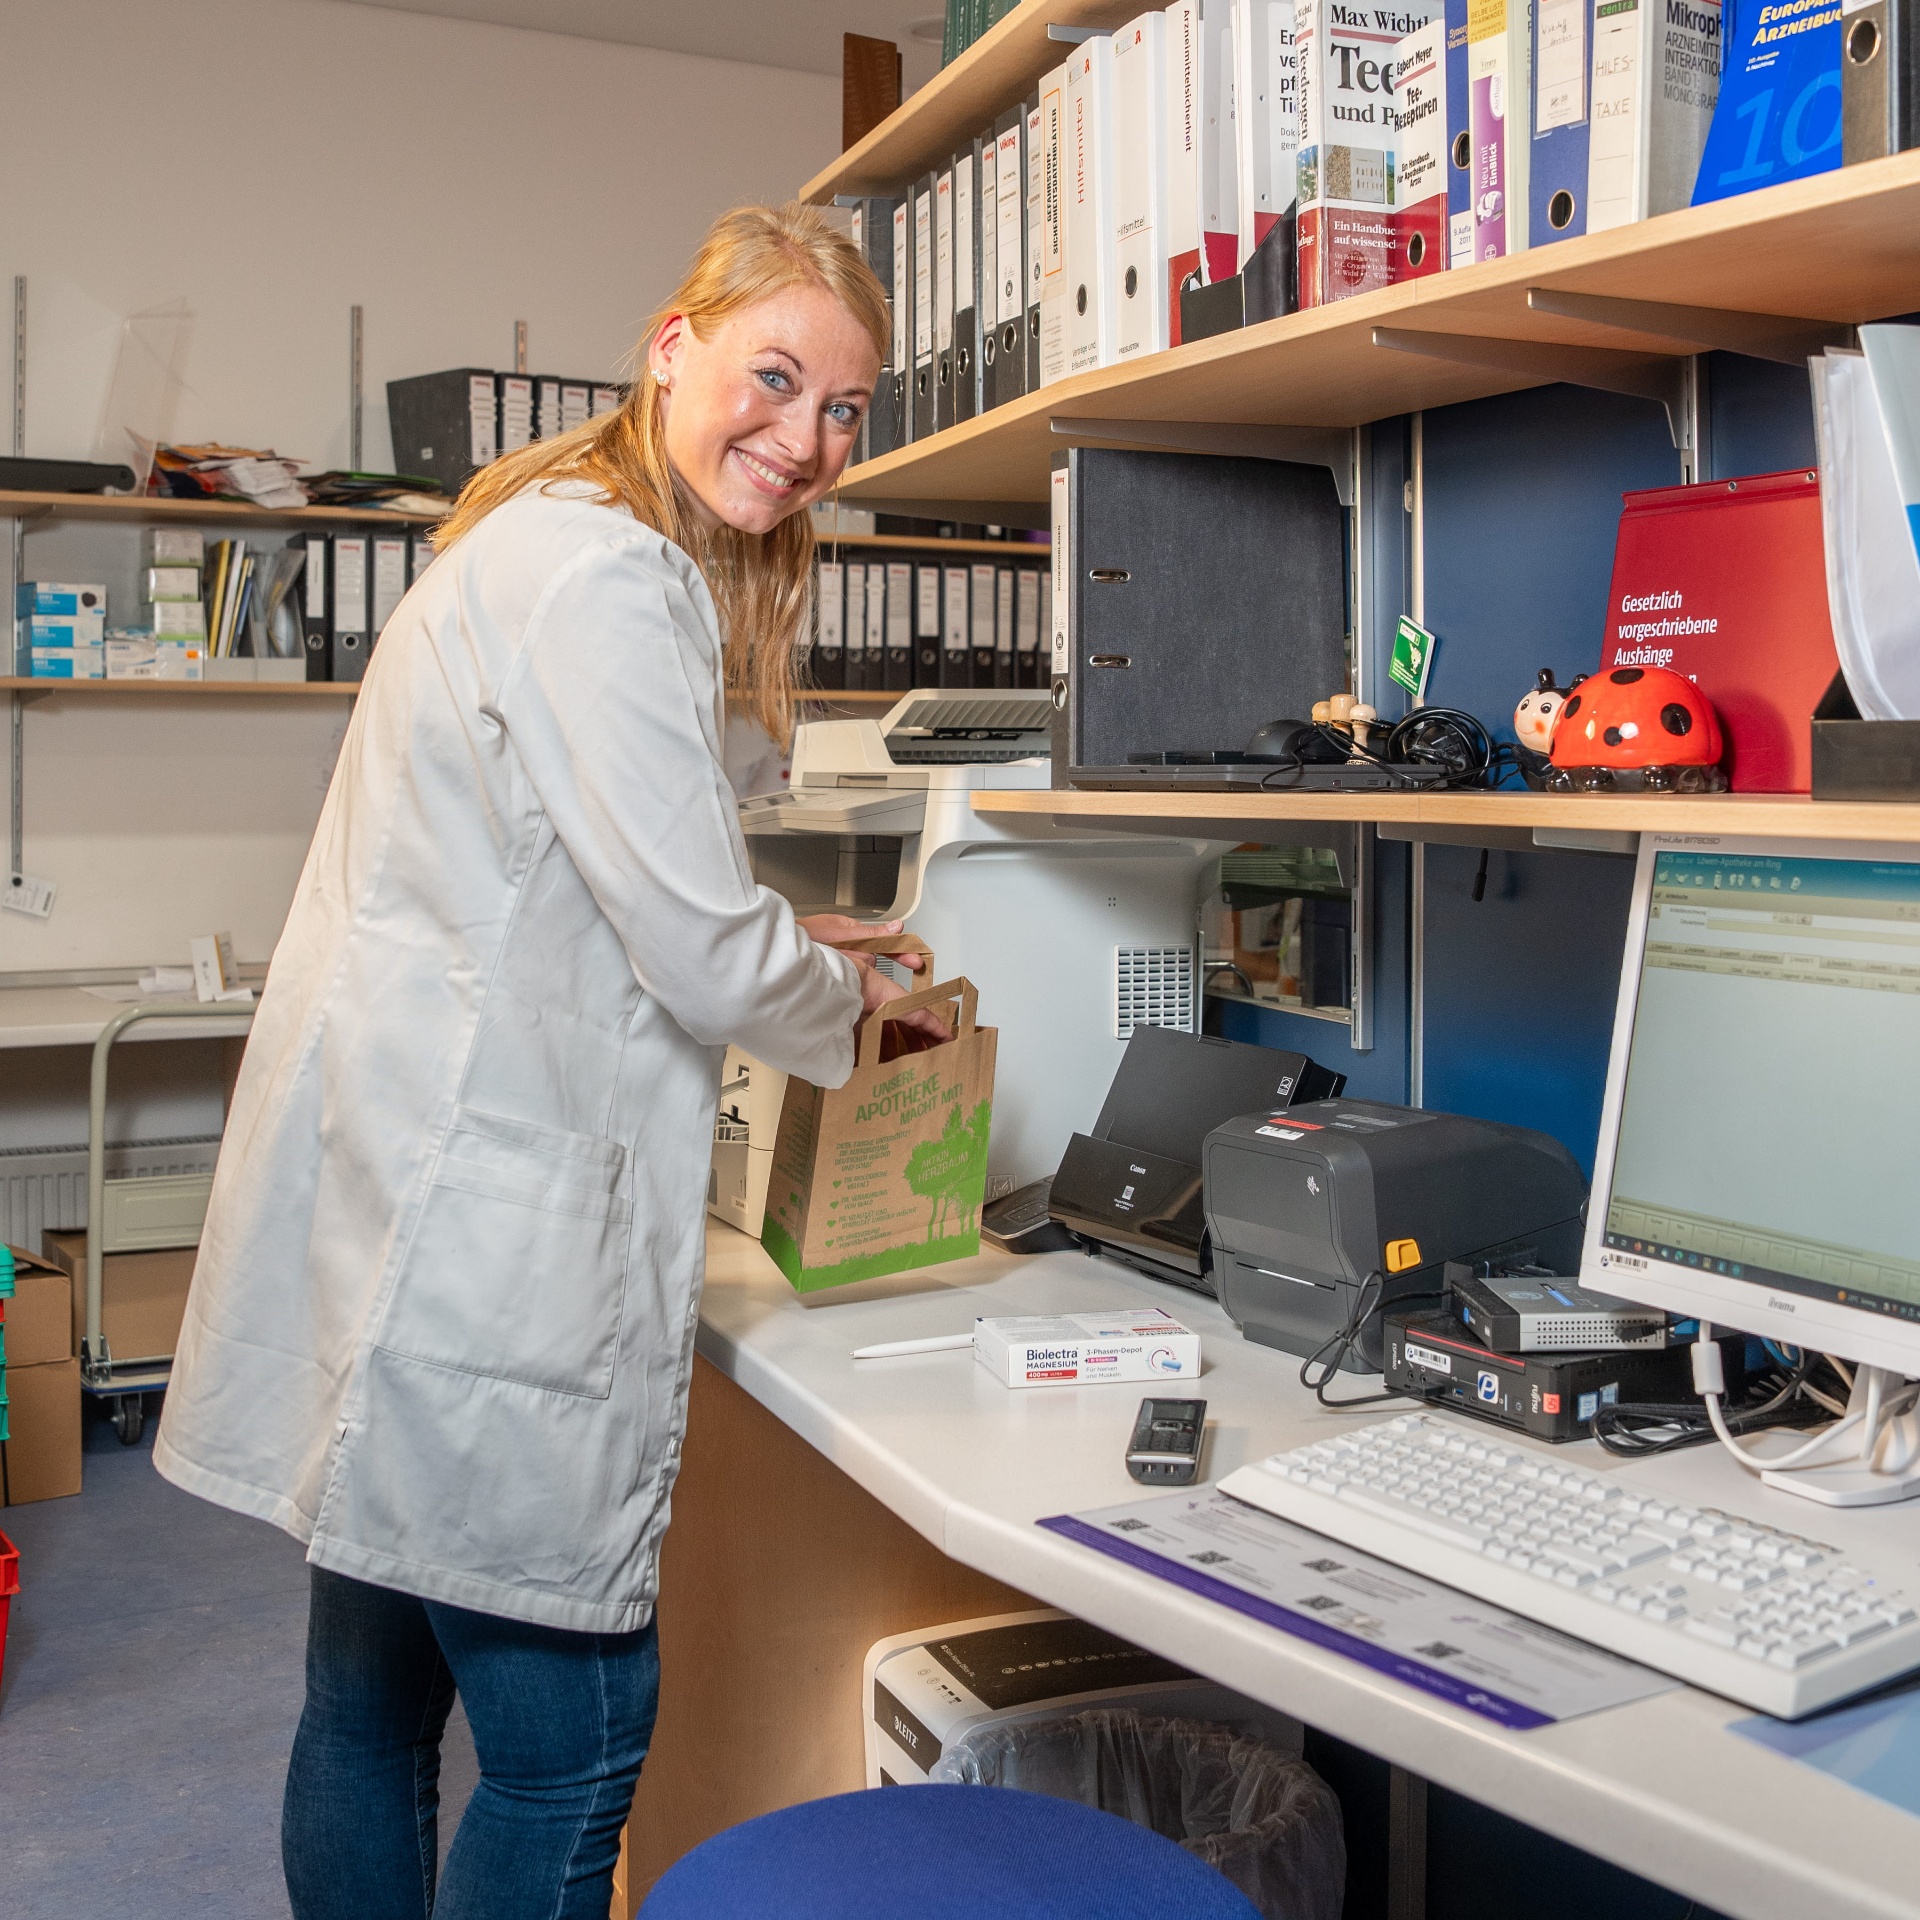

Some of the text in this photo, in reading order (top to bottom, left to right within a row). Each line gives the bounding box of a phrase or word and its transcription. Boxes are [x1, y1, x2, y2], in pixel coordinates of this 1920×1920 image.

[1331, 4, 1368, 28] Max
[1373, 10, 1428, 34] Wichtl
[1471, 7, 1488, 19] GELBE
[1490, 1, 1503, 12] LISTE
[1471, 9, 1504, 26] PHARMINDEX
[1665, 31, 1721, 59] ARZNEIMITT
[1396, 46, 1432, 76] Egbert Meyer
[1596, 55, 1634, 76] HILFS-
[1183, 10, 1192, 153] Arzneimittelsicherheit
[1664, 66, 1692, 86] BAND
[1300, 42, 1310, 141] Teedrogen
[1406, 86, 1422, 106] Tee-
[1332, 103, 1375, 123] und
[1394, 97, 1438, 133] Rezepturen
[1595, 97, 1630, 119] TAXE
[1029, 114, 1040, 131] Vikin
[1717, 69, 1842, 187] 10
[1000, 136, 1016, 151] Viking
[1076, 97, 1084, 204] Hilfsmittel
[1404, 163, 1426, 181] Apotheker
[1427, 158, 1436, 170] und
[1409, 152, 1430, 170] Handbuch
[1480, 145, 1488, 190] Neu mit
[1489, 142, 1498, 187] EinBlick
[1334, 221, 1396, 236] Ein Handbuc
[1334, 235, 1349, 245] auf
[1459, 235, 1471, 245] 2011
[1088, 342, 1097, 351] und
[1071, 354, 1098, 371] Erläuterungen
[1054, 476, 1065, 486] Viking
[1622, 590, 1682, 613] Gesetzlich
[1618, 616, 1718, 642] vorgeschriebene
[1614, 646, 1673, 668] Aushänge
[1654, 836, 1682, 844] ProLite
[1766, 860, 1780, 871] Ring
[872, 1068, 916, 1098] UNSERE
[855, 1072, 940, 1124] APOTHEKE
[900, 1083, 962, 1125] MACHT MIT!
[918, 1151, 969, 1183] HERZBAUM
[921, 1148, 949, 1169] AKTION
[1026, 1349, 1078, 1360] Biolectra
[1086, 1346, 1142, 1356] 3-Phasen-Depot
[1026, 1360, 1078, 1370] MAGNESIUM
[1530, 1384, 1542, 1414] FUJITSU
[898, 1720, 918, 1749] LEITZ
